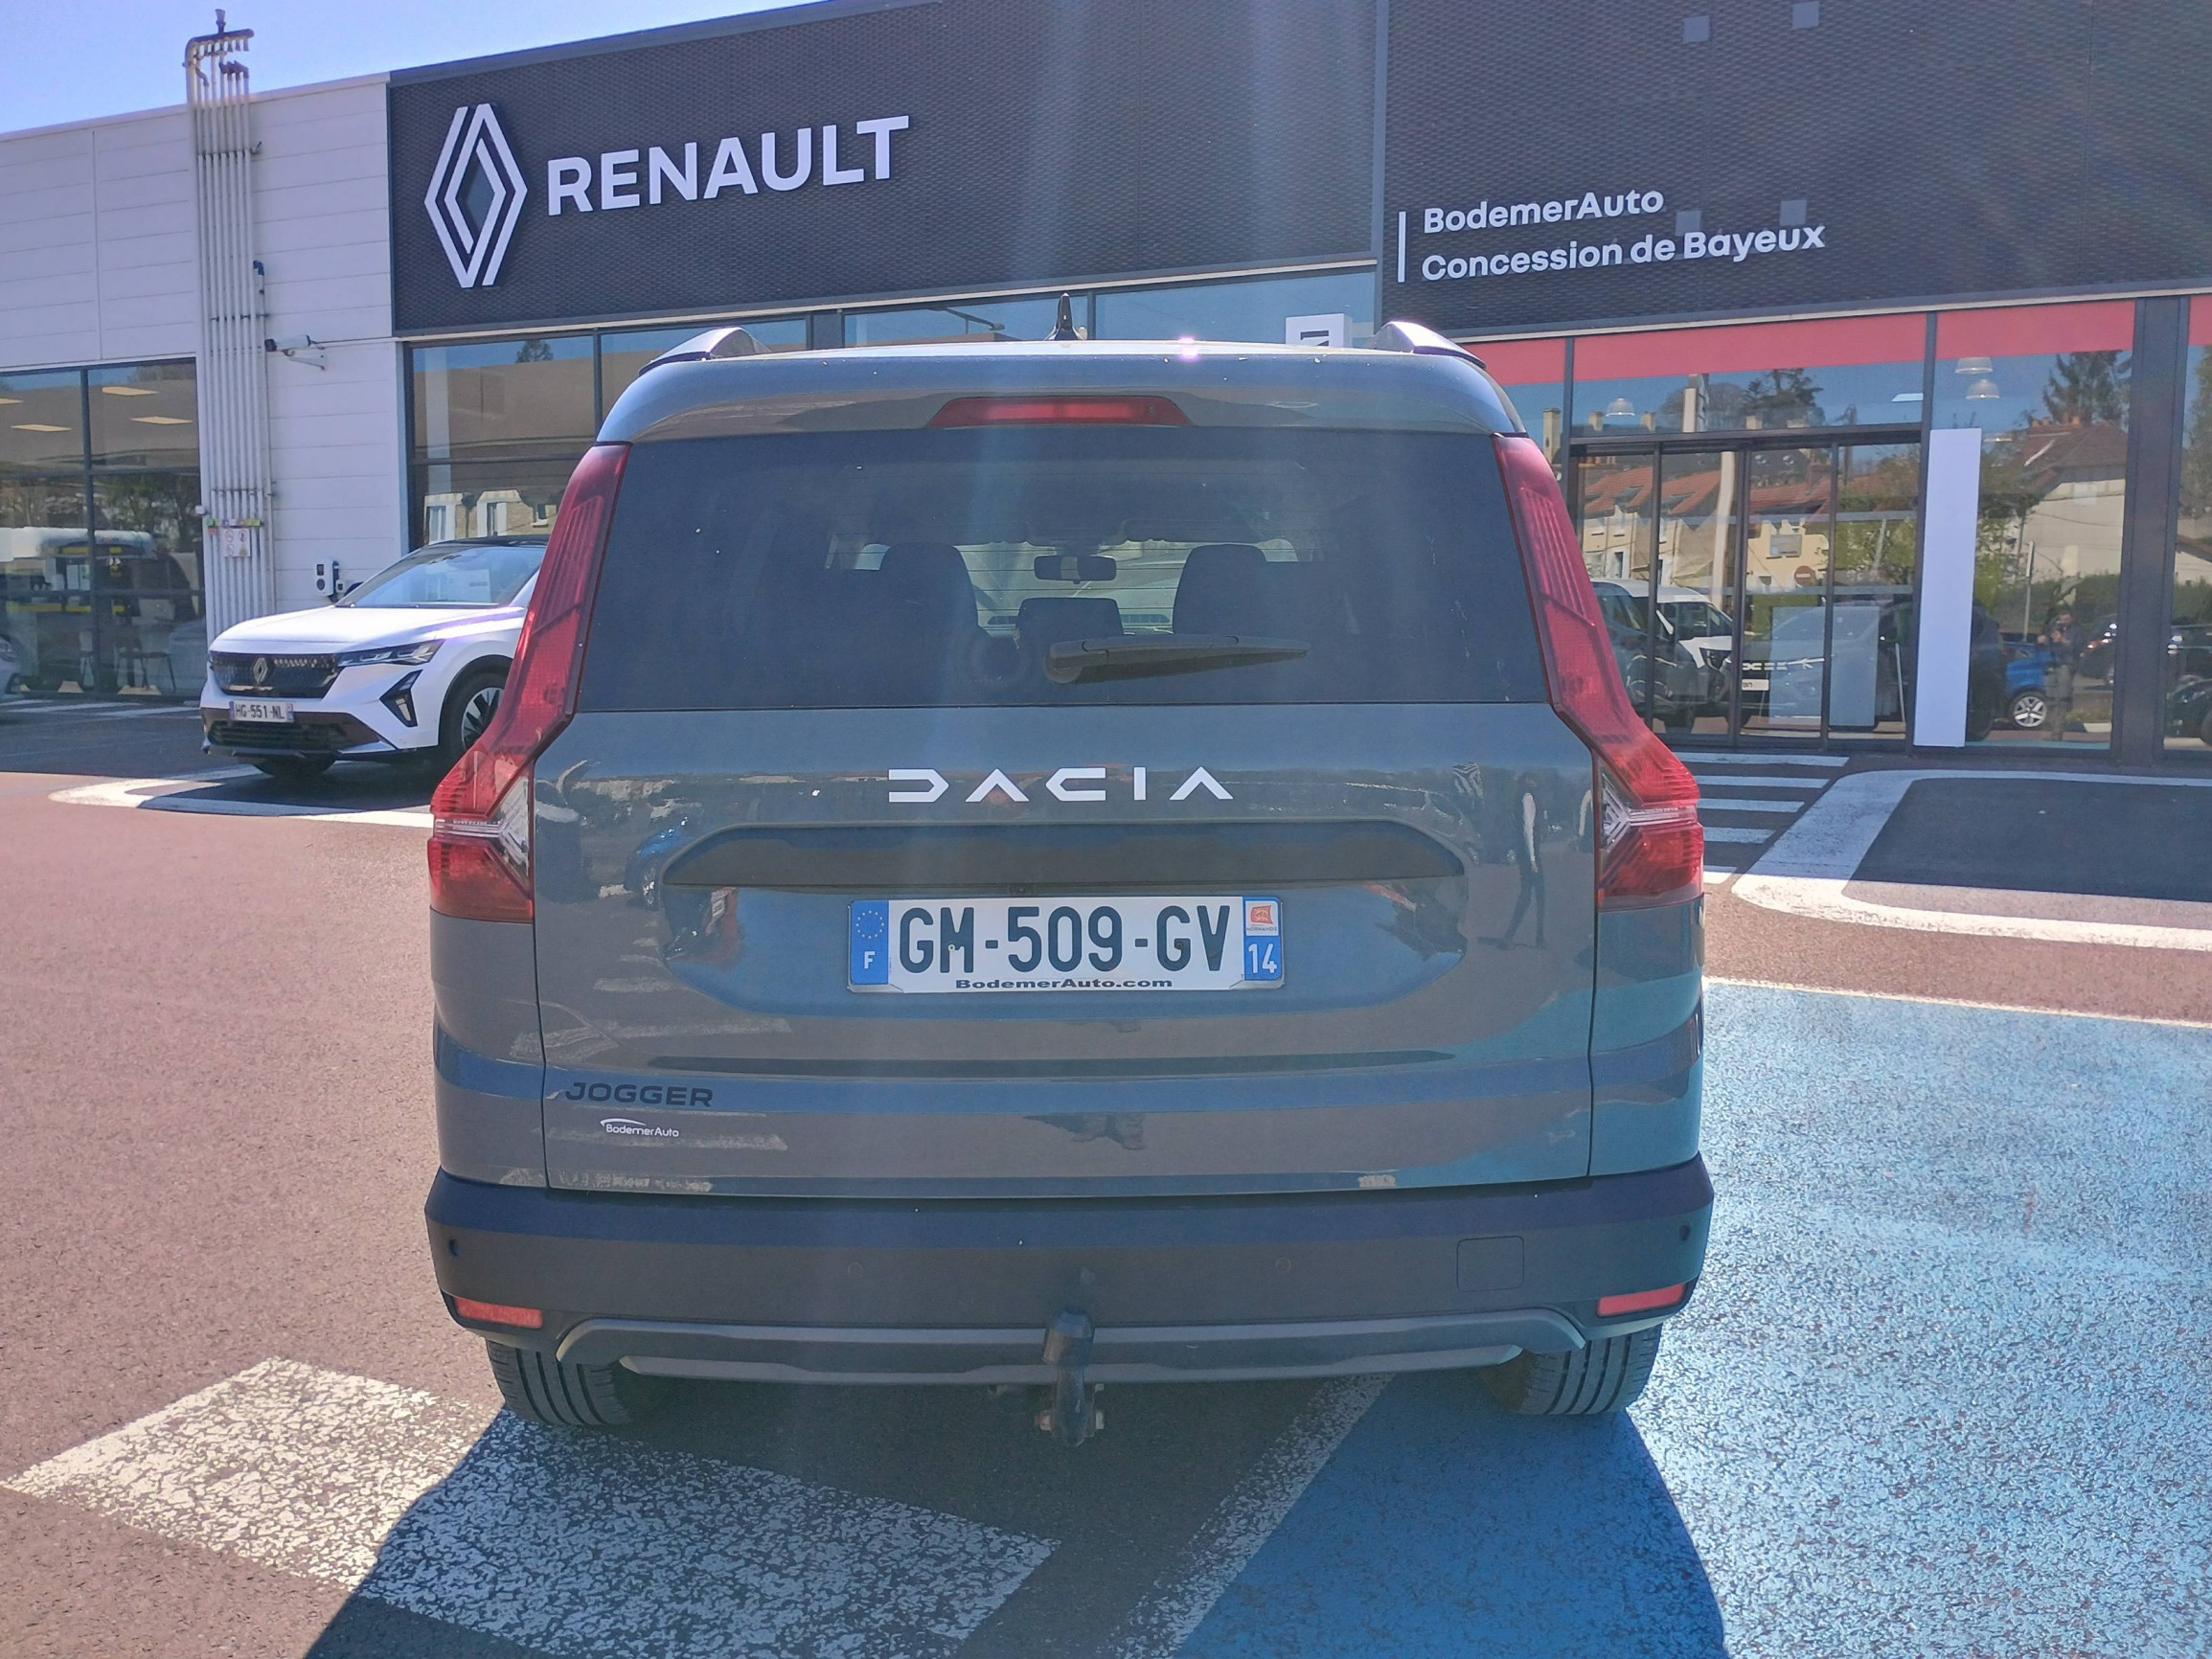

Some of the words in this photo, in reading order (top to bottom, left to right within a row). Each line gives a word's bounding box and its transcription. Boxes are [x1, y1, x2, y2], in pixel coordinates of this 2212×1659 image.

[547, 114, 910, 216] RENAULT
[1423, 190, 1665, 234] BodemerAuto
[1421, 239, 1623, 282] Concession
[1630, 234, 1676, 264] de
[1682, 224, 1826, 262] Bayeux
[235, 704, 285, 719] HG-551-NL
[888, 766, 1235, 804] DACIA
[899, 905, 1231, 973] GM-509-GV
[864, 950, 876, 969] F
[1248, 943, 1278, 974] 14
[955, 978, 1173, 989] BodemerAuto.com
[565, 1082, 714, 1107] JOGGER
[605, 1124, 680, 1138] BodemerAuto
